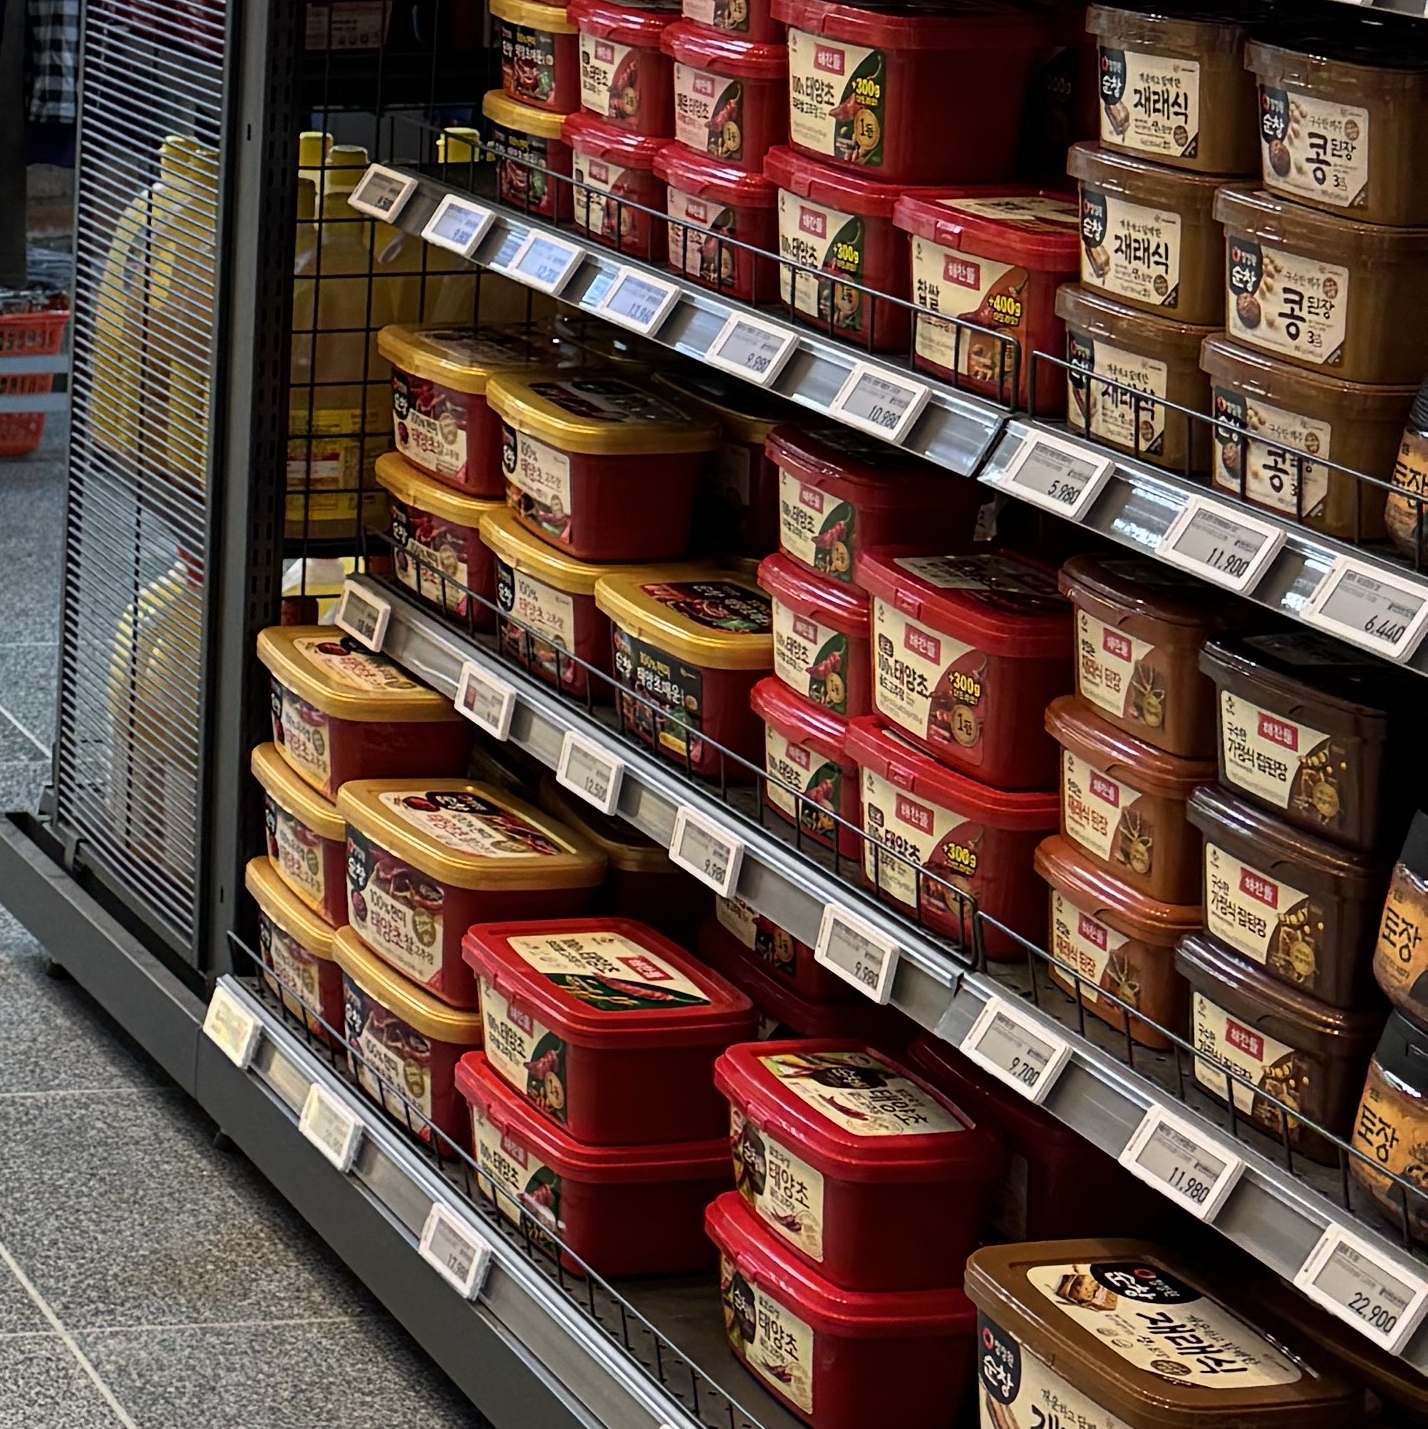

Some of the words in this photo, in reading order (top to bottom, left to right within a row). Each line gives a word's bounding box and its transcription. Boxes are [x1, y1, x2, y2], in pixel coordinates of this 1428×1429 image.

[805, 77, 836, 106] 태양초
[1102, 74, 1123, 97] 순창
[1133, 86, 1190, 125] 재래식
[1262, 112, 1285, 137] 순창
[1304, 130, 1333, 186] 콩
[1331, 138, 1357, 161] 된장
[1083, 217, 1103, 242] 순창
[1113, 232, 1170, 270] 재래식
[946, 261, 977, 285] 해찬들
[1231, 265, 1259, 296] 순창
[916, 278, 941, 312] 찹쌀
[987, 294, 1022, 318] +400g
[1277, 285, 1308, 342] 콩
[1306, 295, 1336, 320] 된장
[1207, 547, 1250, 577] 11,900
[907, 629, 939, 660] 해찬들
[1364, 614, 1406, 644] 6,440
[893, 658, 930, 698] 태양초
[948, 671, 982, 697] +300g
[1227, 721, 1248, 740] 구수한
[1261, 720, 1295, 746] 해찬들
[1227, 736, 1256, 768] 가정식
[1255, 751, 1289, 783] 집된장
[1091, 810, 1109, 837] 된장
[942, 842, 977, 869] +300g
[1210, 874, 1231, 897] 구수한
[1243, 877, 1276, 905] 해찬들
[1210, 889, 1238, 923] 가정식
[1237, 906, 1268, 939] 집된장
[1078, 951, 1097, 979] 된장
[500, 1020, 527, 1057] 태양초
[1229, 1025, 1261, 1056] 해찬들
[868, 1087, 930, 1129] 태양초
[493, 1152, 521, 1190] 태양초
[768, 1159, 811, 1209] 태양초
[1167, 1165, 1209, 1204] 11,980
[1347, 1291, 1399, 1335] 22,900
[757, 1311, 800, 1362] 태양초
[1136, 1309, 1249, 1377] 재래식
[983, 1352, 1015, 1399] 순창
